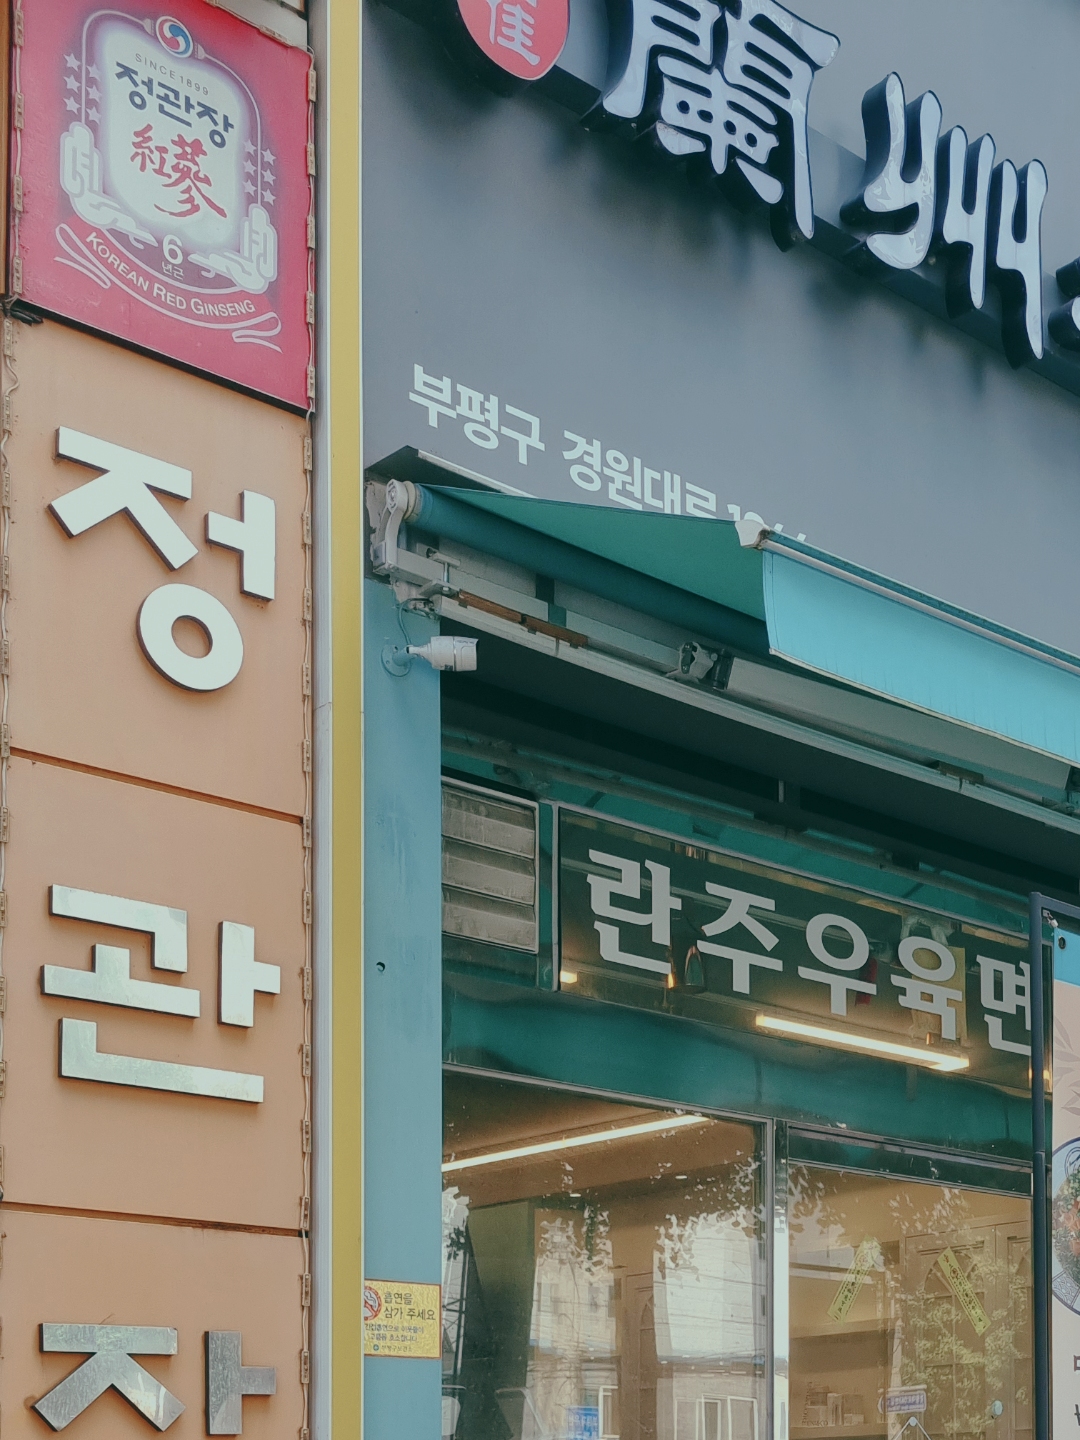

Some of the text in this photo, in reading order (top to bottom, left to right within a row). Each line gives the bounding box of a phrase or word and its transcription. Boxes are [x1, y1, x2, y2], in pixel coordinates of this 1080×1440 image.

[135, 52, 209, 97] SINCE 1899
[115, 61, 235, 149] 정관장
[161, 234, 184, 265] 6
[161, 261, 184, 281] 년근
[408, 363, 546, 466] 부평구
[585, 847, 1032, 1056] 란주우육면
[383, 1291, 413, 1305] 흡연을
[383, 1306, 436, 1321] 삼가 주세요
